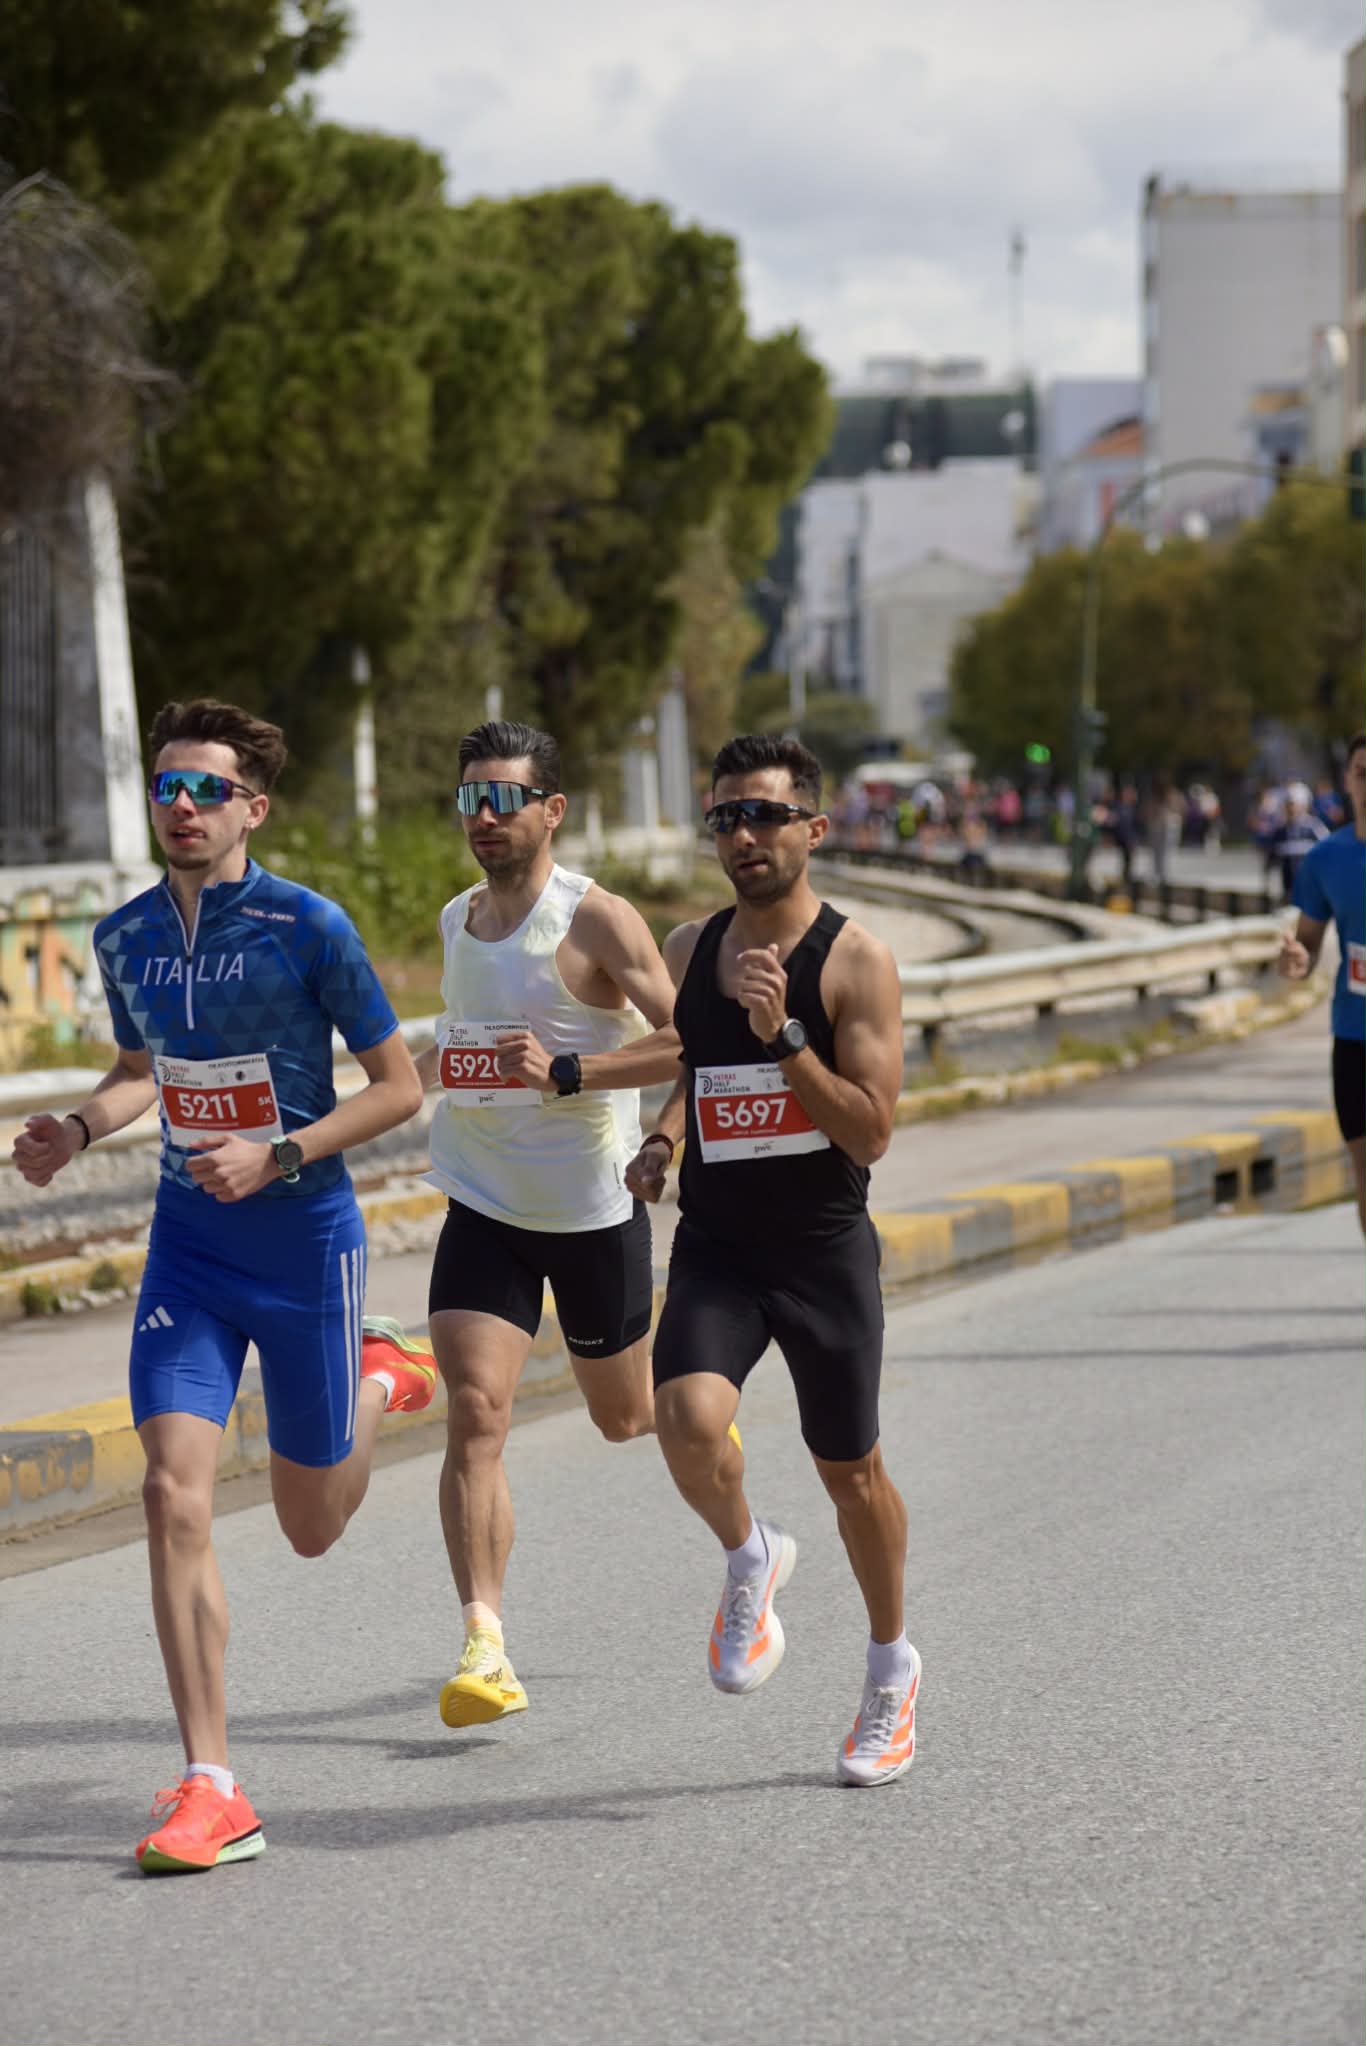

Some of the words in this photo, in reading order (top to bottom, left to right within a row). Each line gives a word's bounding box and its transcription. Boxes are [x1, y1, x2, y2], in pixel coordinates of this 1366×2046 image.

[142, 952, 244, 986] ITALIA
[713, 1086, 751, 1095] MARATHON
[177, 1092, 239, 1120] 5211
[715, 1098, 787, 1128] 5697
